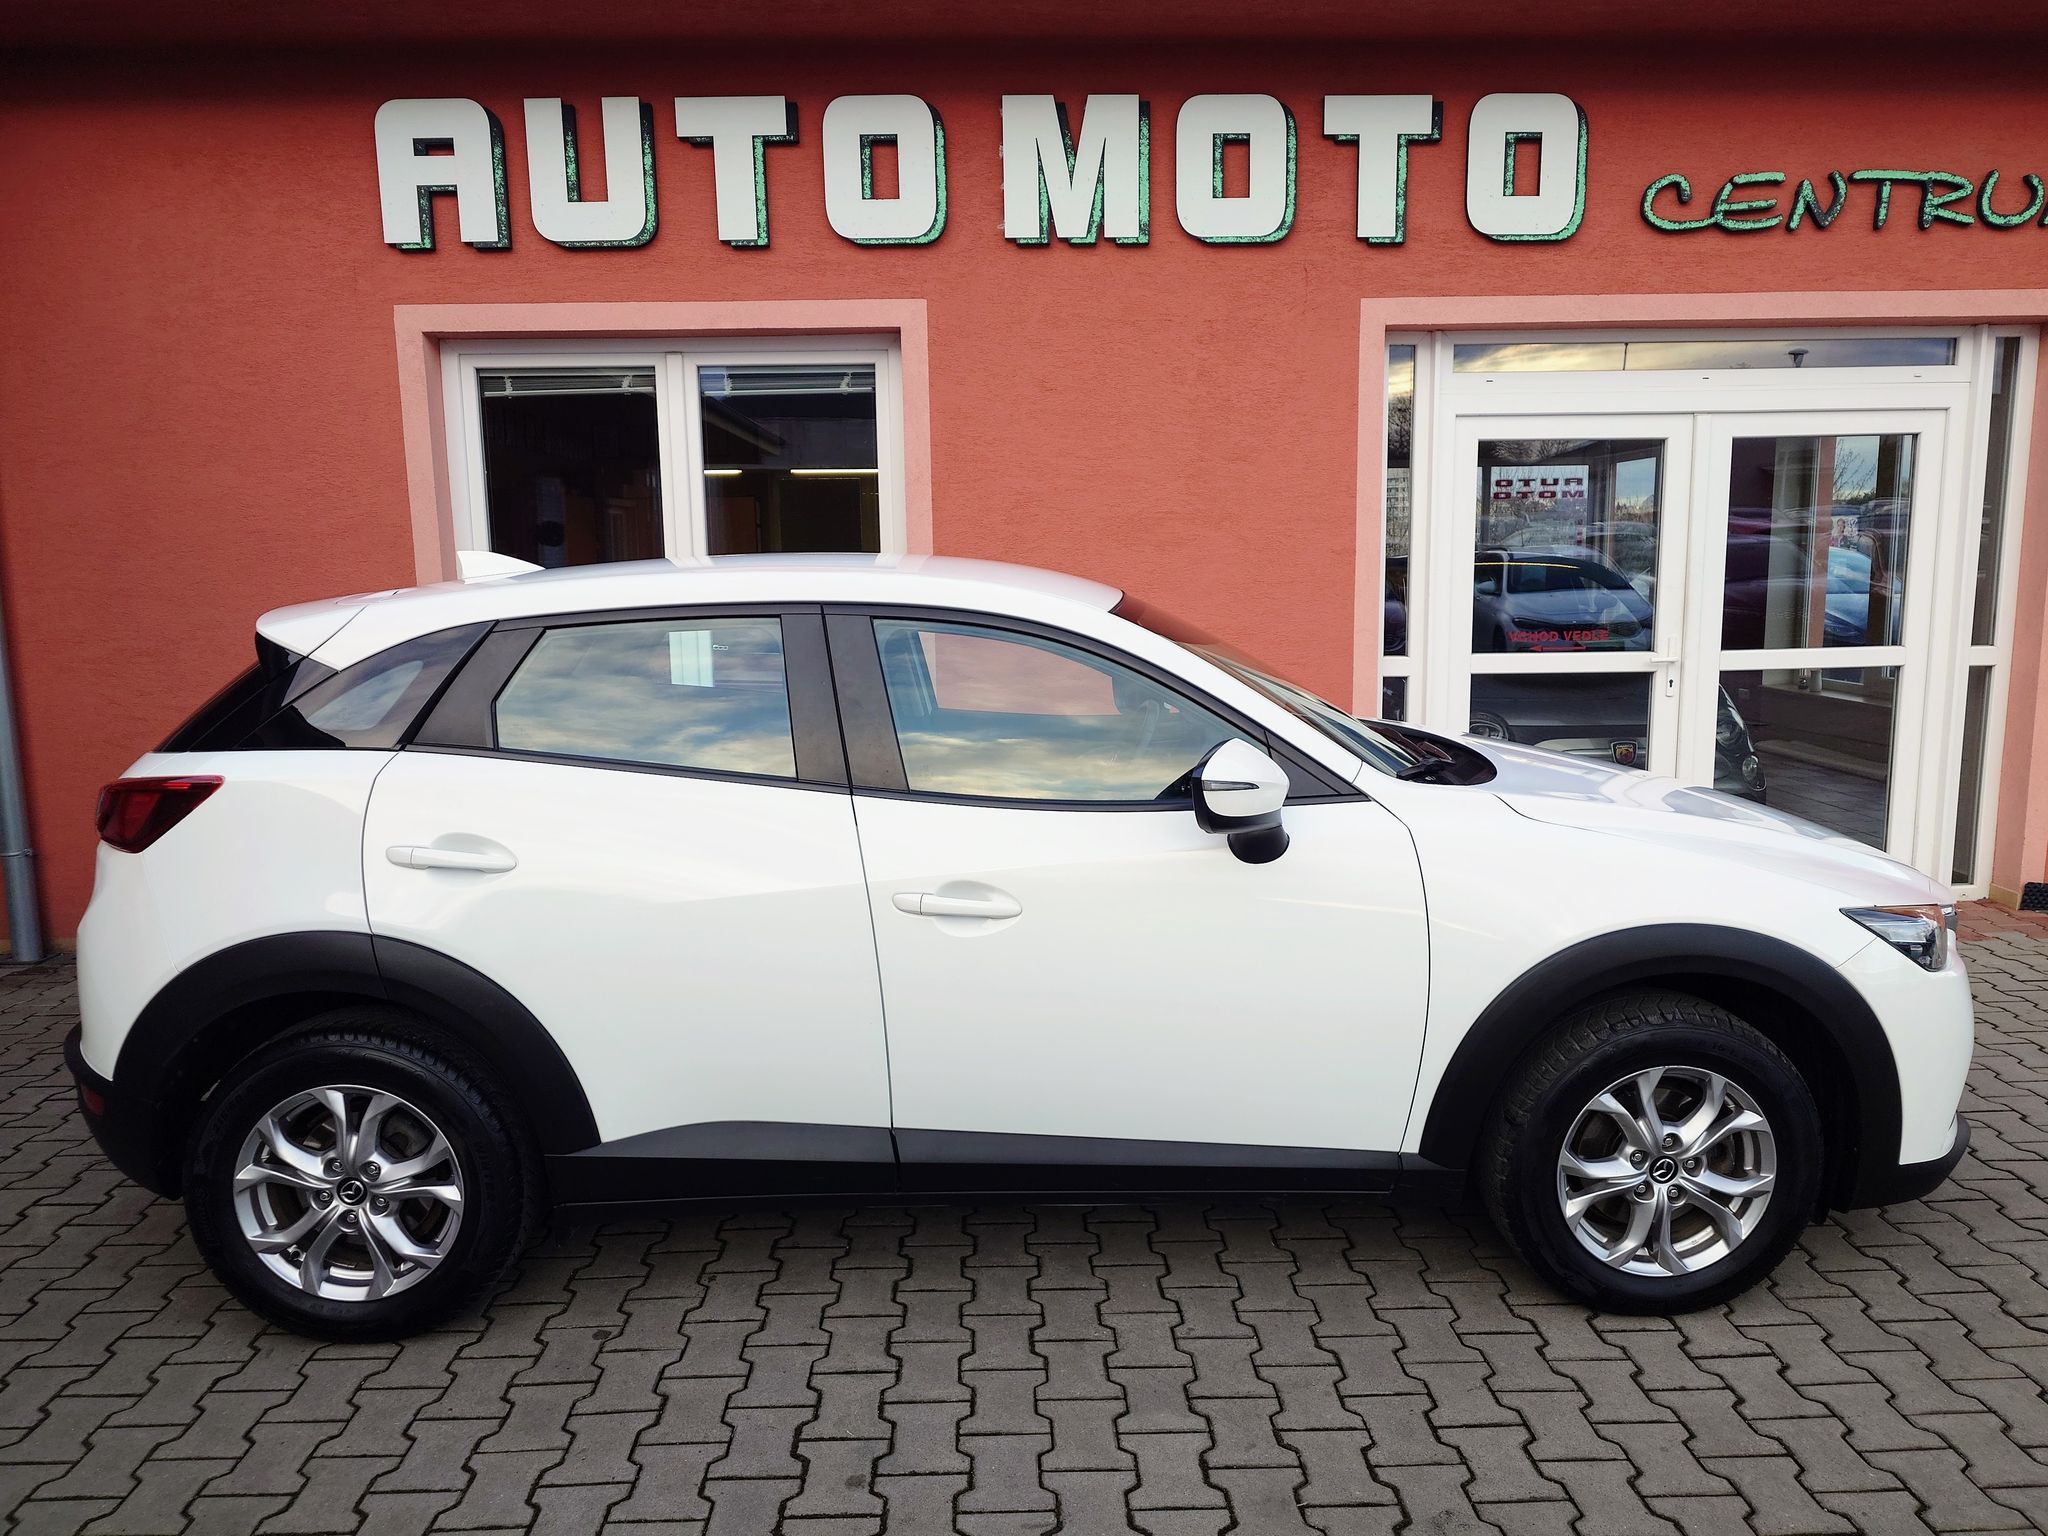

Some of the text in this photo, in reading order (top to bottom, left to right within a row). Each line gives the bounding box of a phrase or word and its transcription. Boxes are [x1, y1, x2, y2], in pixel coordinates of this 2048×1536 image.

[374, 93, 2048, 251] AUTO MOTO CENTRU
